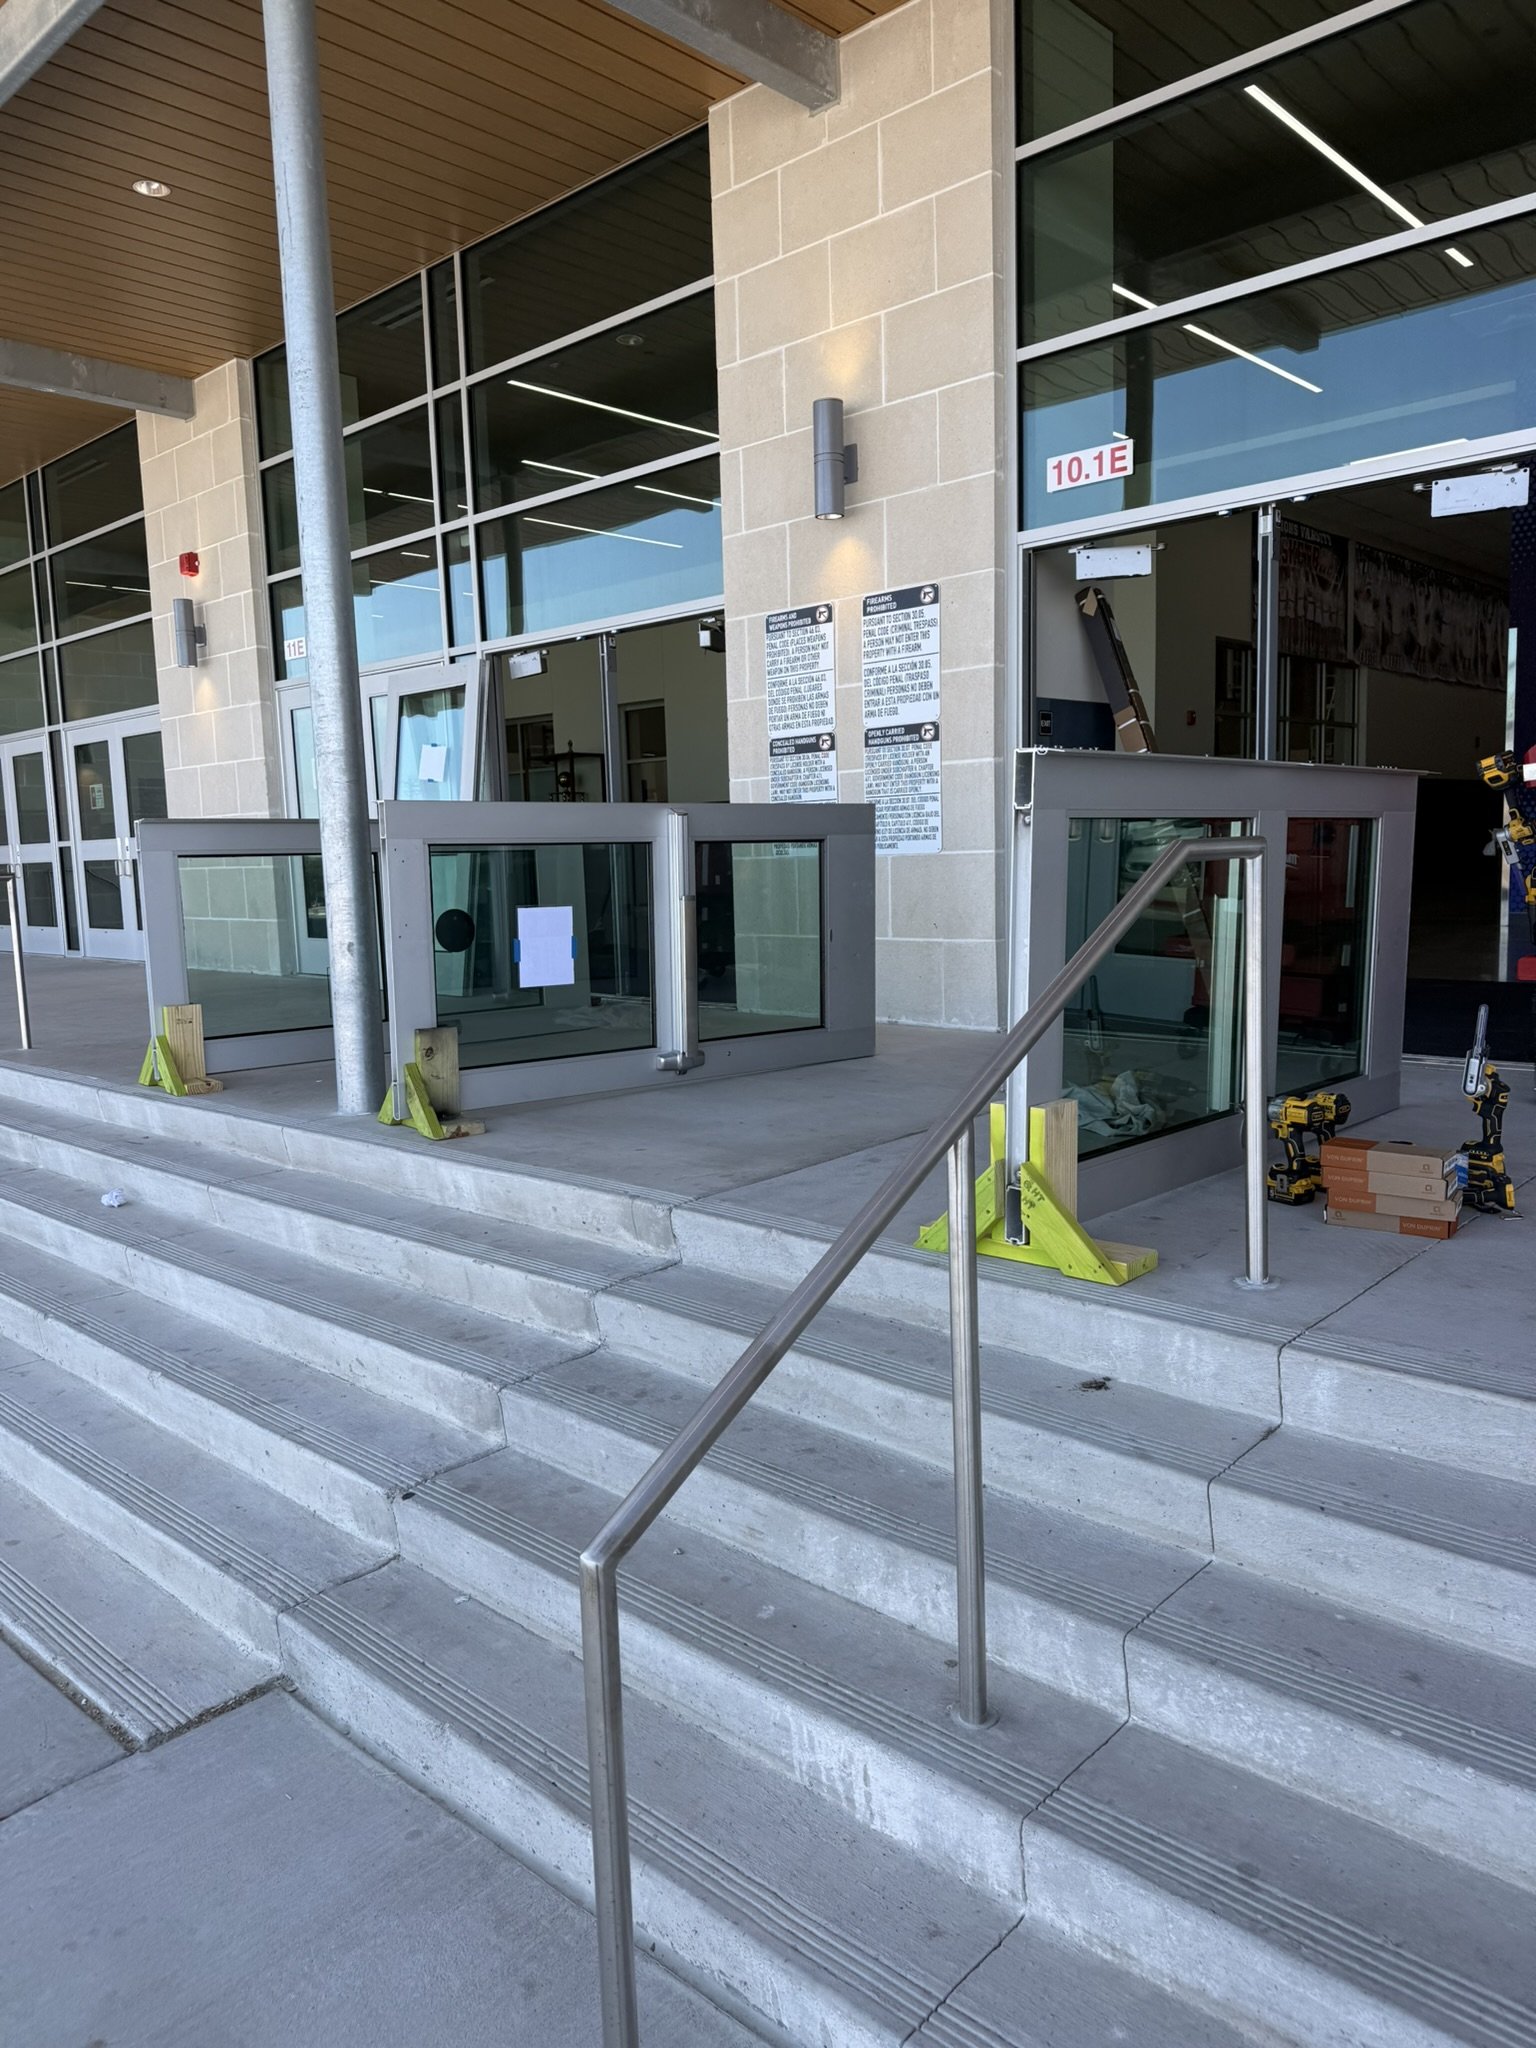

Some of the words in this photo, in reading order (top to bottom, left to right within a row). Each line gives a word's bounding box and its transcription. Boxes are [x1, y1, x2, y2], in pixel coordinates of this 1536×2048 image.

[1052, 444, 1128, 486] 10.1E
[867, 594, 892, 605] FIREARMS
[867, 602, 897, 613] PROHIBITED
[287, 640, 304, 657] 11E
[868, 729, 884, 738] OPENLY
[886, 727, 905, 736] CARRIED
